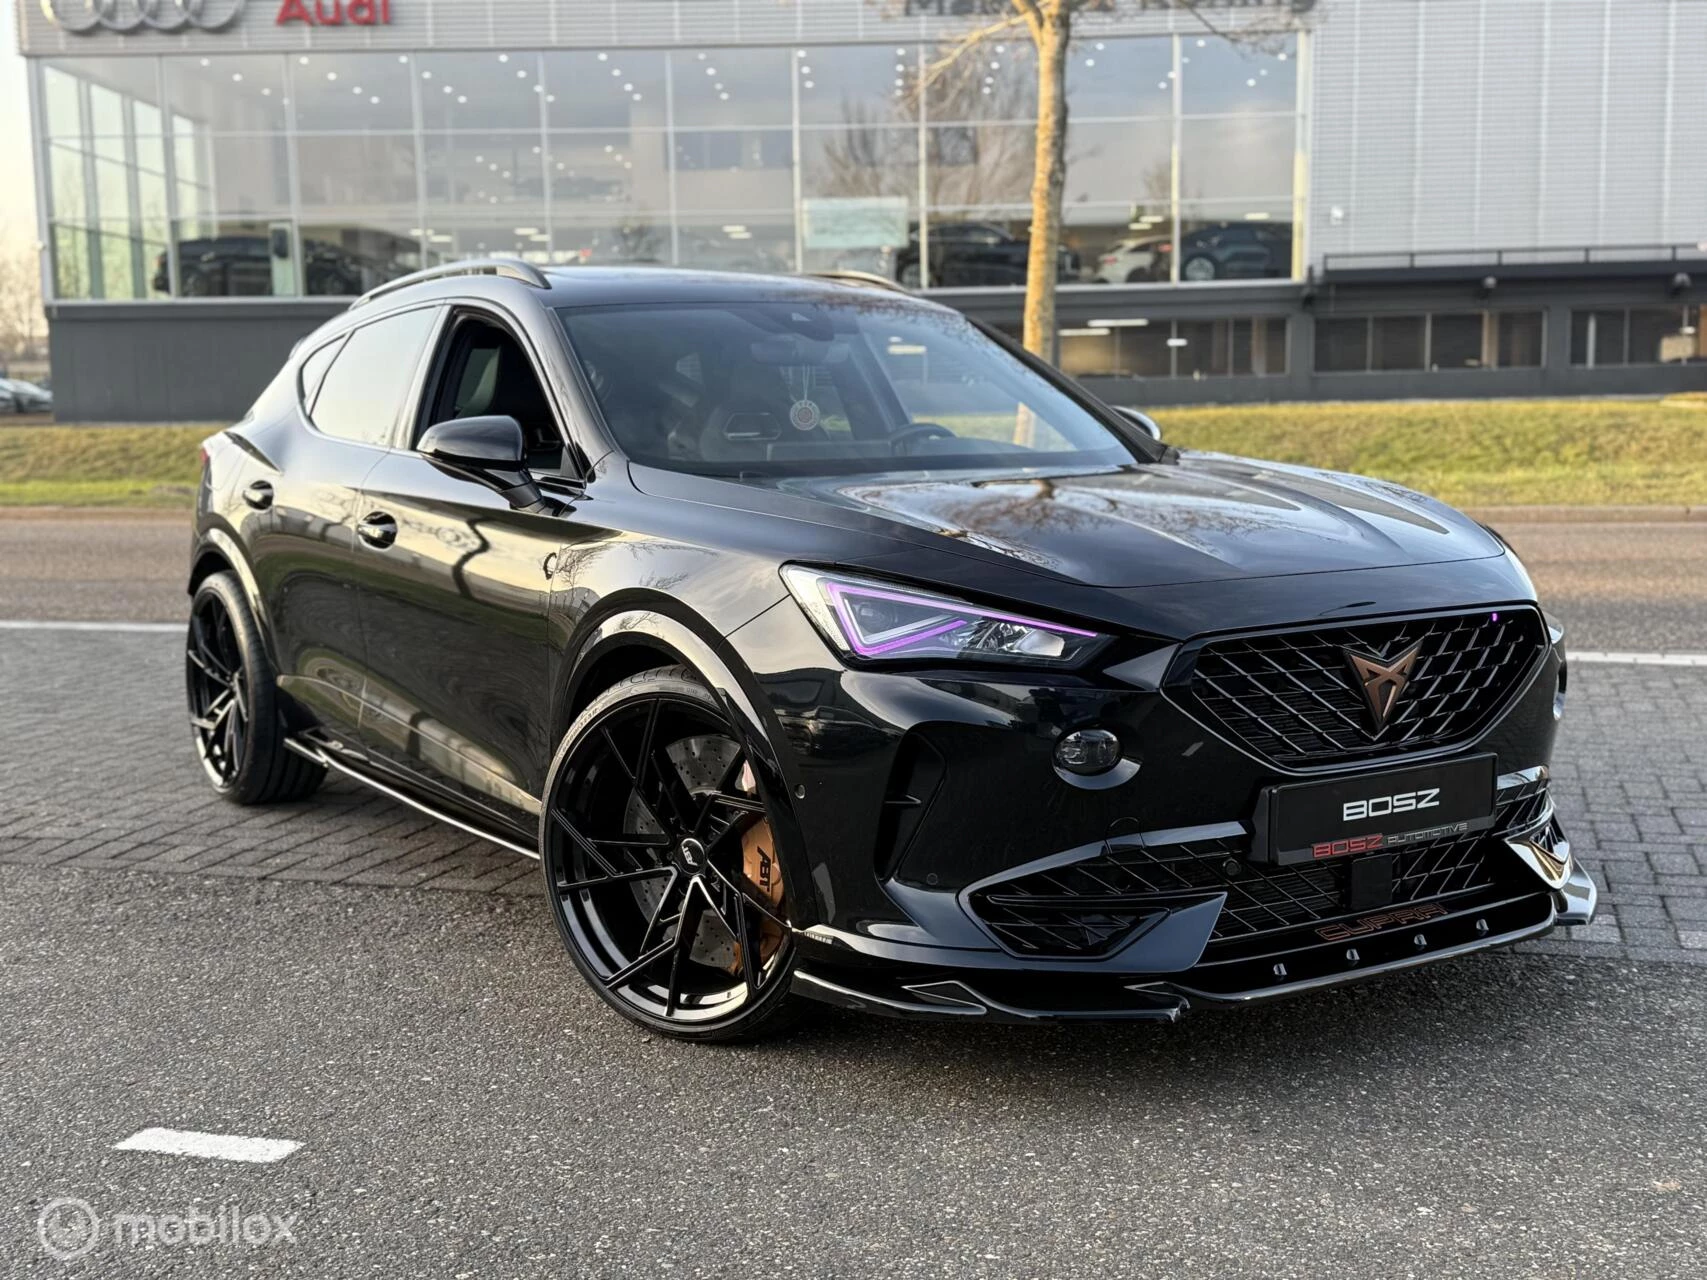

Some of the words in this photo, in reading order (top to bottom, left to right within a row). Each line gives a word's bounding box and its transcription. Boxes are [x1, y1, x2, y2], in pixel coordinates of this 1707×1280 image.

[276, 0, 390, 26] Audi
[1342, 787, 1440, 822] BOSZ
[1312, 833, 1384, 858] BOSZ
[1387, 822, 1469, 845] AUTOMOTIVE
[756, 846, 772, 892] ABT
[1314, 901, 1449, 941] CUPRA
